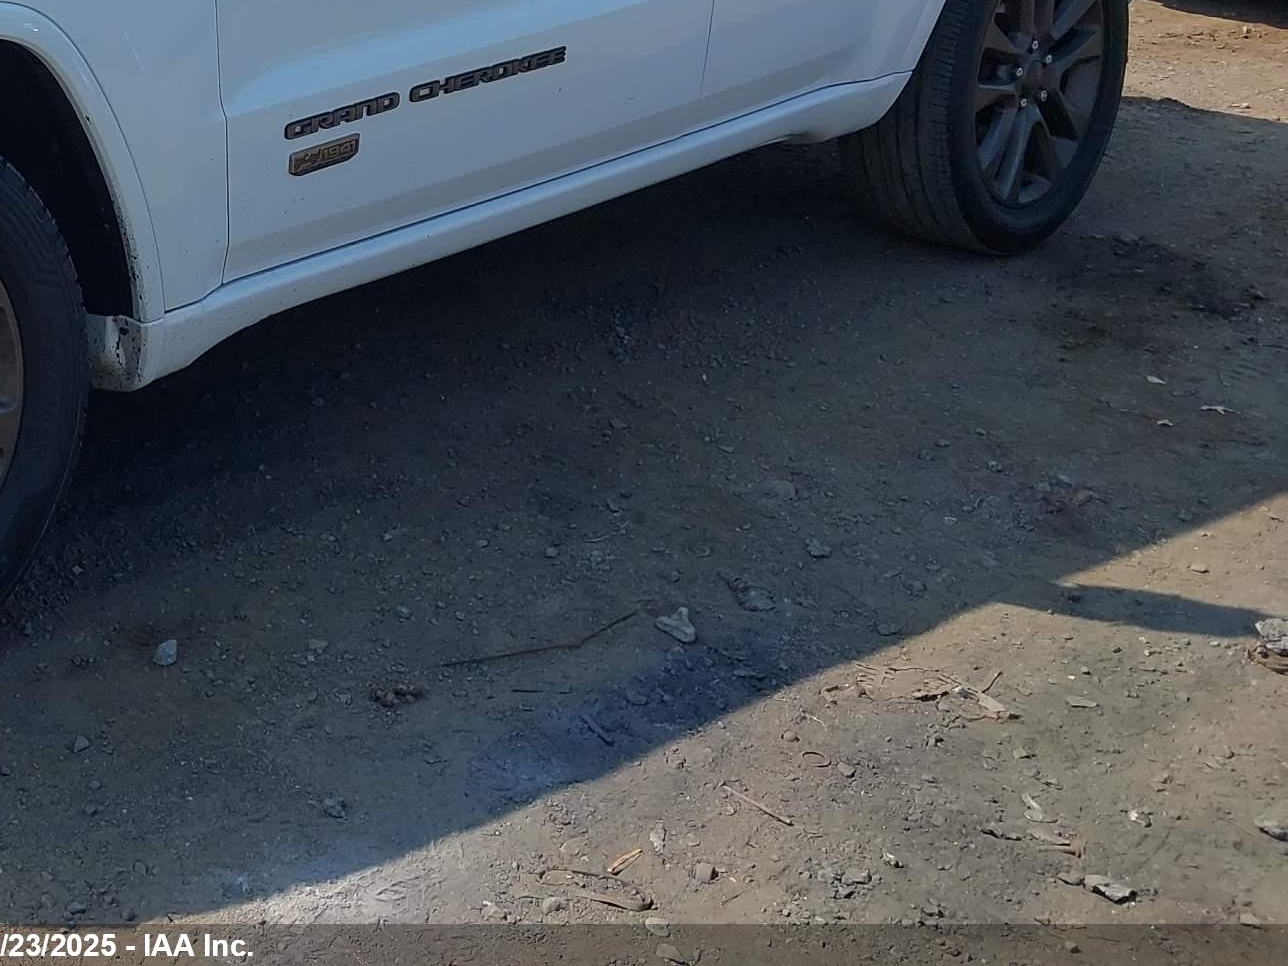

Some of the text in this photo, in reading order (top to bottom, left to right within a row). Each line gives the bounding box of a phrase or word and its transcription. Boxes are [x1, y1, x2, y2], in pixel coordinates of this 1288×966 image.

[284, 45, 567, 139] GRAND CHEROKEE
[322, 139, 357, 160] 1941
